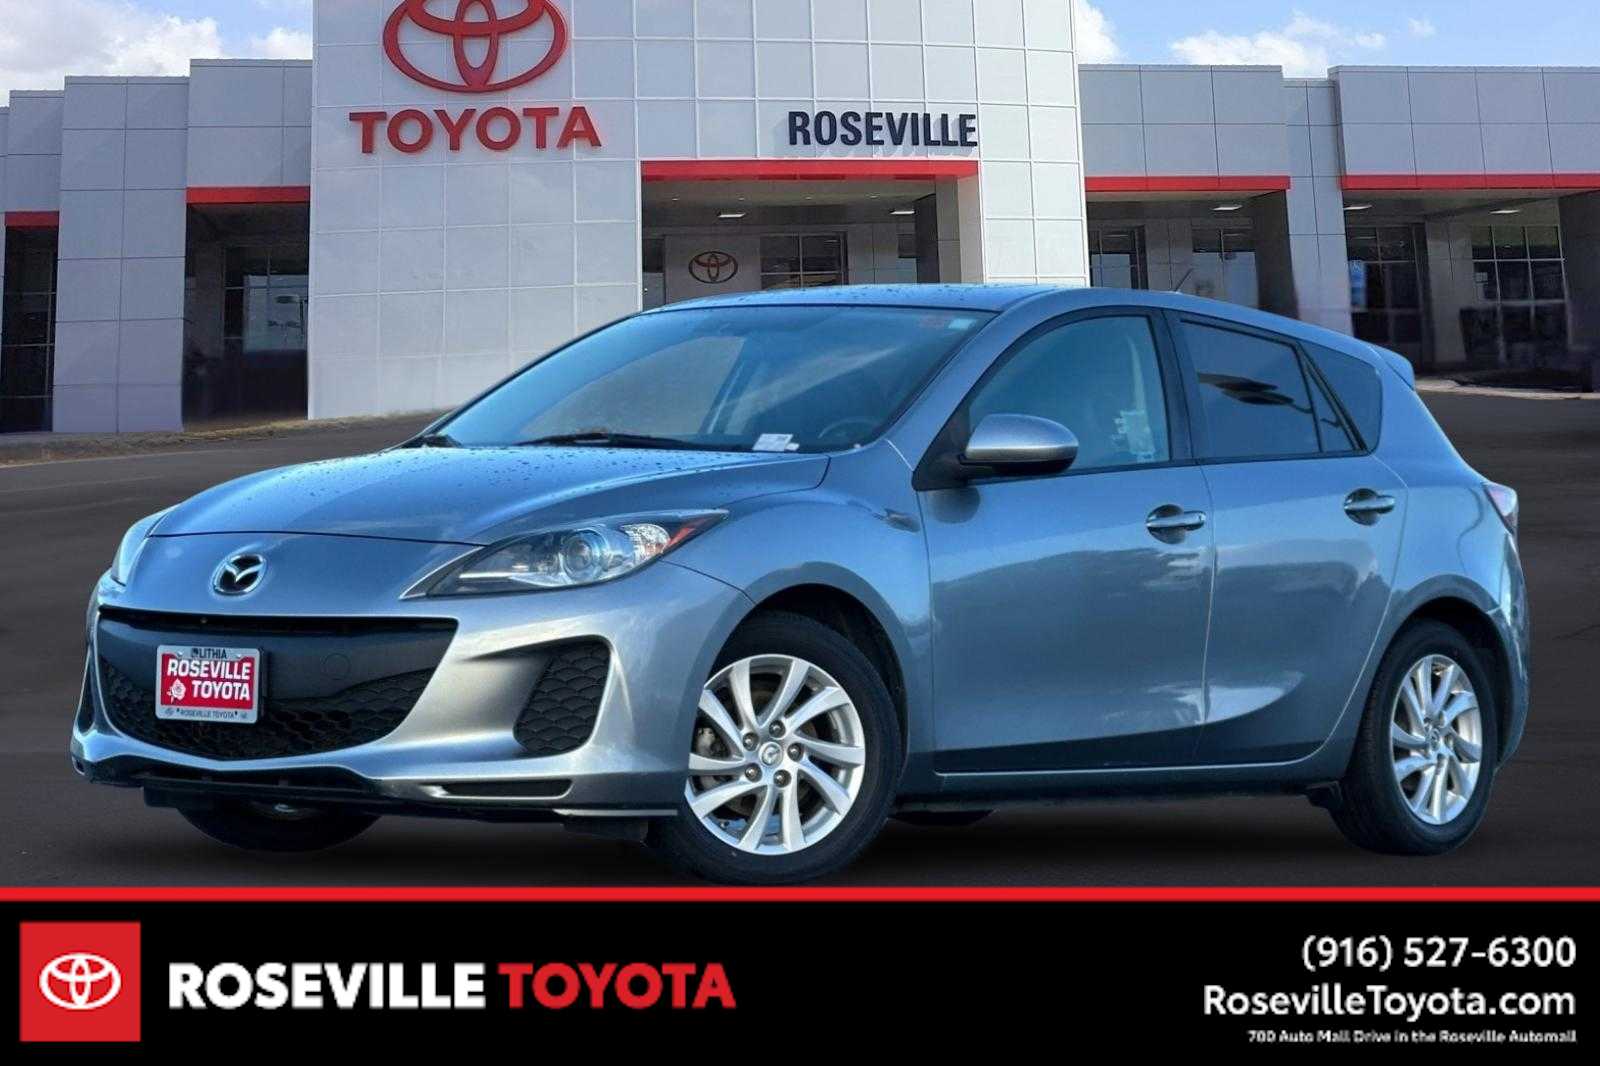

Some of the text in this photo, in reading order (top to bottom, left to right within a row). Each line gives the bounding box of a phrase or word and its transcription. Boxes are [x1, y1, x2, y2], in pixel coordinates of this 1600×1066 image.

[349, 106, 602, 154] TOYOTA
[788, 110, 978, 148] ROSEVILLE
[167, 658, 251, 679] ROSEVILLE
[192, 681, 250, 700] TOYOTA
